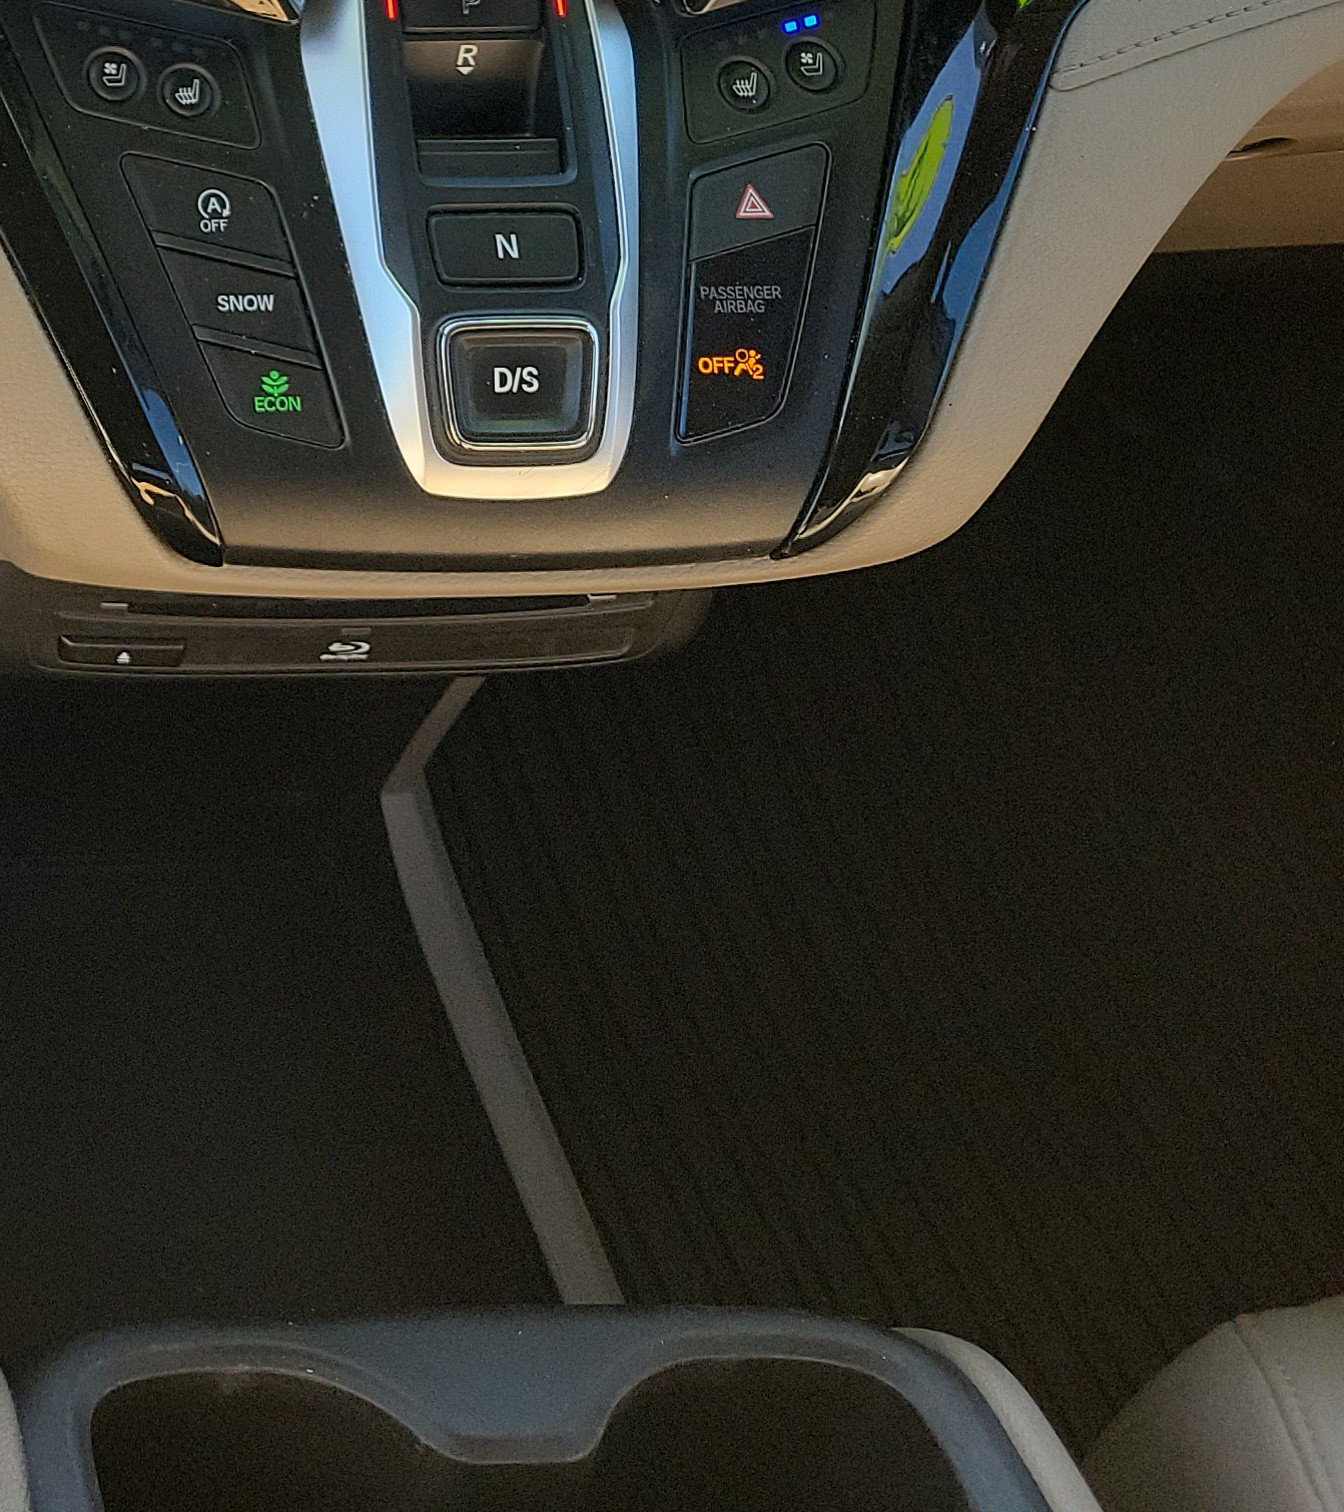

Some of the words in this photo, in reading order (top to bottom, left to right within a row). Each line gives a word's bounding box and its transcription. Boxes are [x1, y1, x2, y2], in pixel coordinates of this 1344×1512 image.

[457, 44, 478, 66] R
[200, 219, 229, 232] OFF
[495, 233, 520, 260] N
[700, 285, 782, 300] PASSENGER
[217, 294, 275, 312] SNOW
[714, 299, 765, 313] AIRBAG
[698, 357, 734, 375] OFF
[493, 366, 540, 394] D/S
[253, 396, 302, 413] ECON
